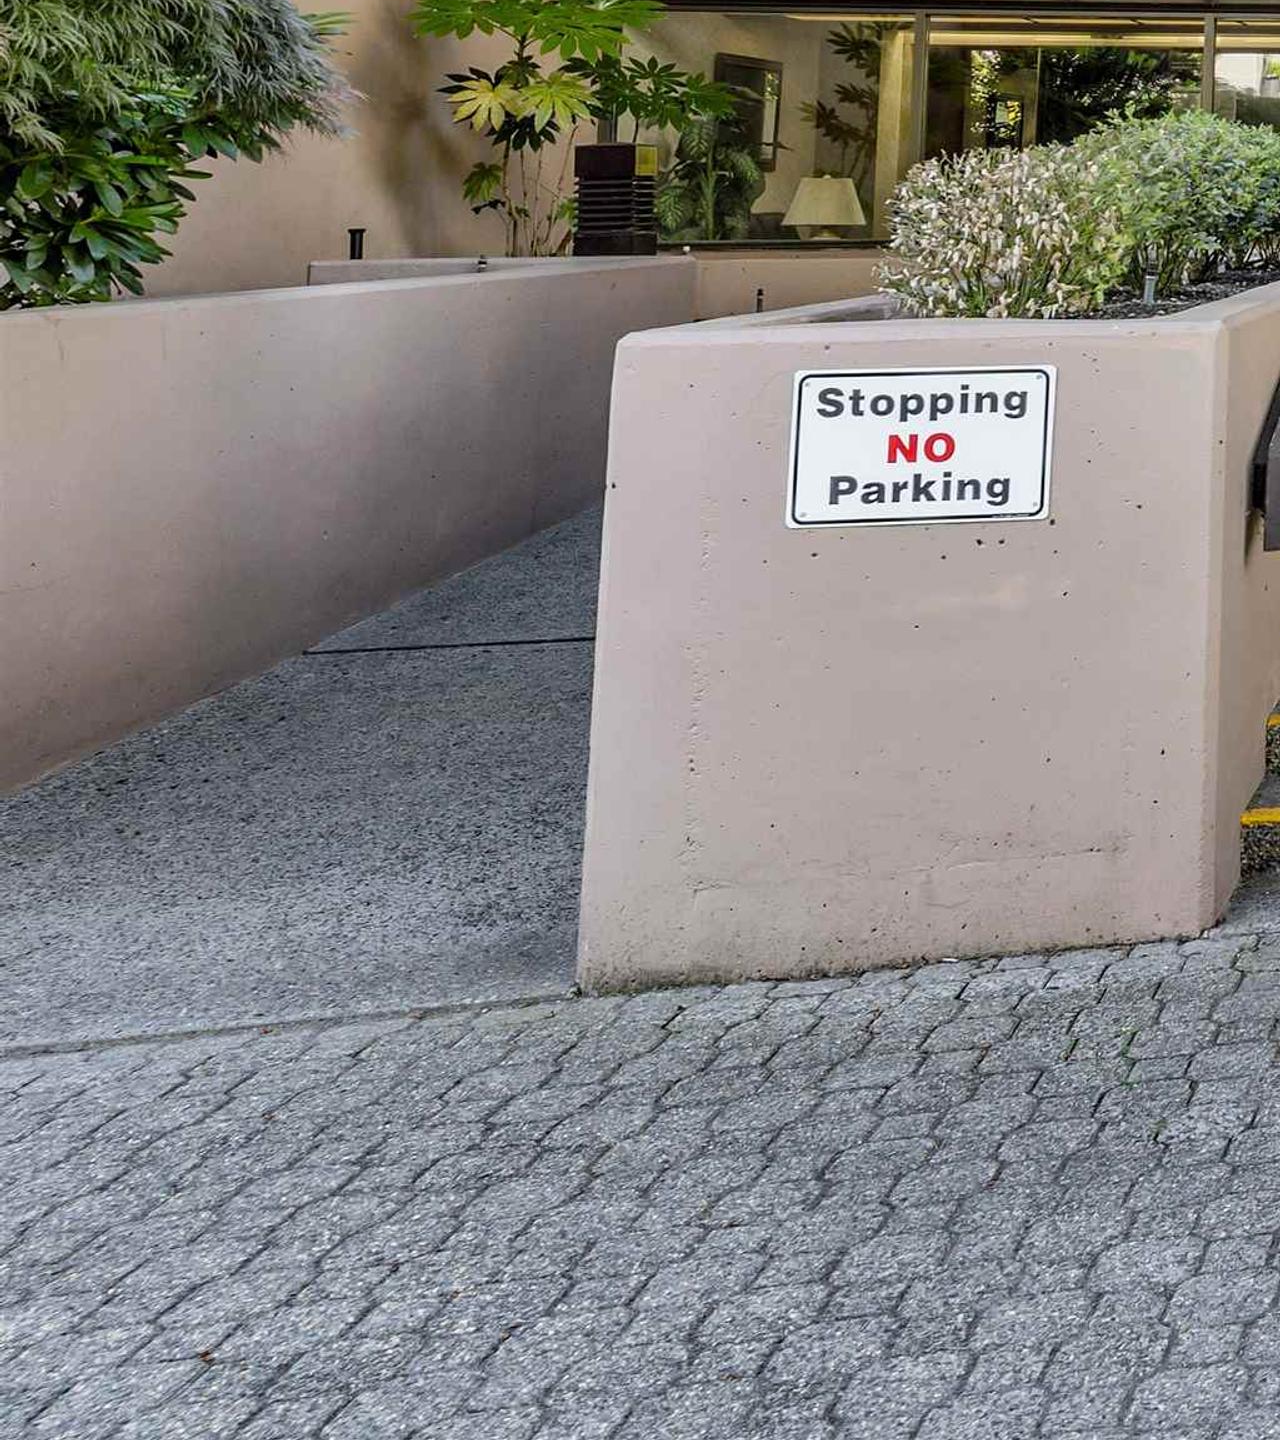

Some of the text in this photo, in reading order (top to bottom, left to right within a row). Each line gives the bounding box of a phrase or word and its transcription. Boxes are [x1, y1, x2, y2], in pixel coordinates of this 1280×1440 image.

[817, 385, 1028, 422] Stopping
[887, 433, 955, 463] NO
[829, 472, 1011, 506] Parking
